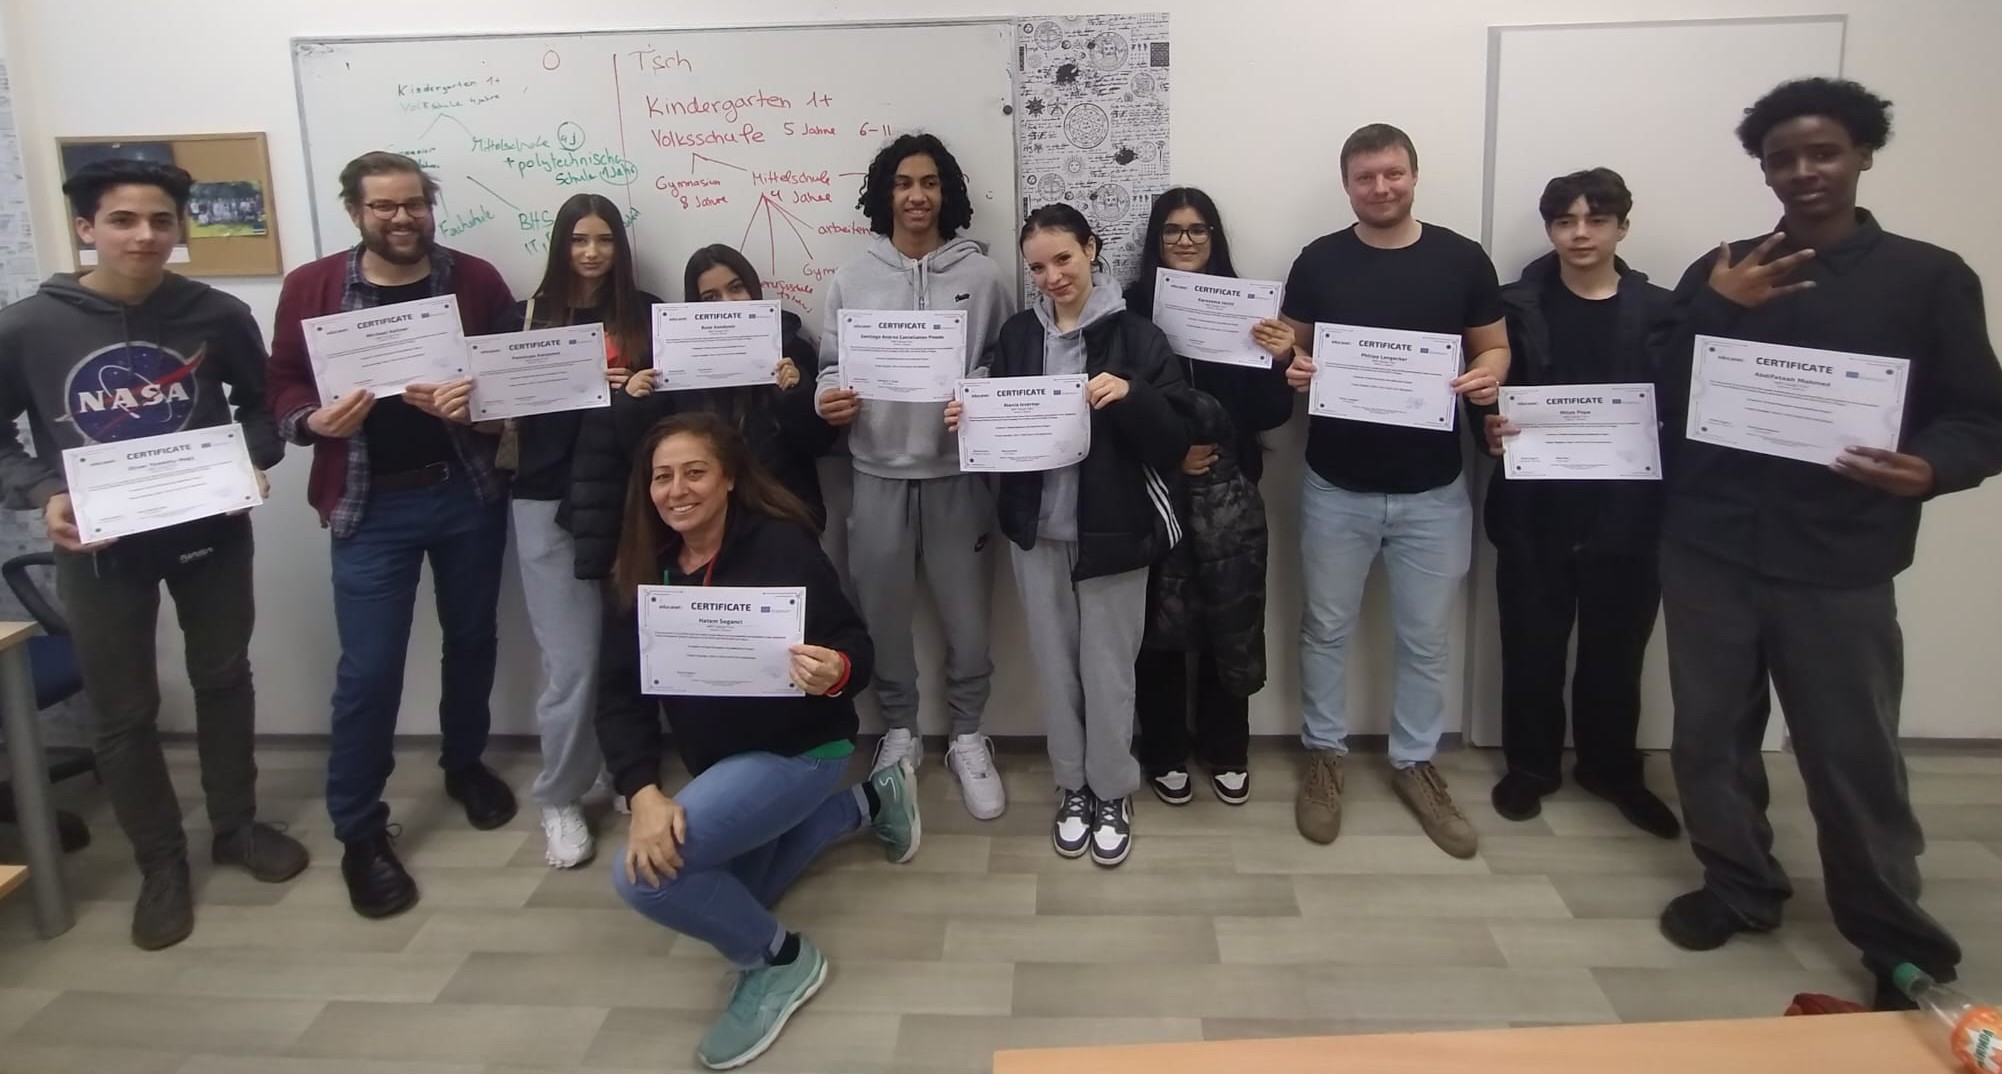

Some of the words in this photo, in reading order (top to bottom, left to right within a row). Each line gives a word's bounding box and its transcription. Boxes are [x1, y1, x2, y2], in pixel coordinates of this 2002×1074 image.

[646, 89, 792, 123] Kindergarten
[806, 91, 833, 108] 1+
[651, 123, 765, 147] Volksschule
[784, 122, 794, 135] 5
[655, 175, 721, 197] Gymnasium
[752, 171, 830, 186] Mittelschule
[680, 196, 688, 209] 8
[518, 210, 554, 230] BHS
[818, 221, 871, 236] arbeiten
[1194, 285, 1241, 297] CERTIFICATE
[357, 314, 412, 329] CERTIFICATE
[695, 312, 742, 320] CERTIFICATE
[509, 339, 561, 350] CERTIFICATE
[1358, 339, 1412, 351] CERTIFICATE
[1756, 357, 1833, 374] CERTIFICATE
[77, 382, 190, 414] NASA
[996, 388, 1046, 397] CERTIFICATE
[1546, 397, 1603, 405] CERTIFICATE
[126, 444, 191, 460] CERTIFICATE
[690, 601, 752, 612] CERTIFICATE
